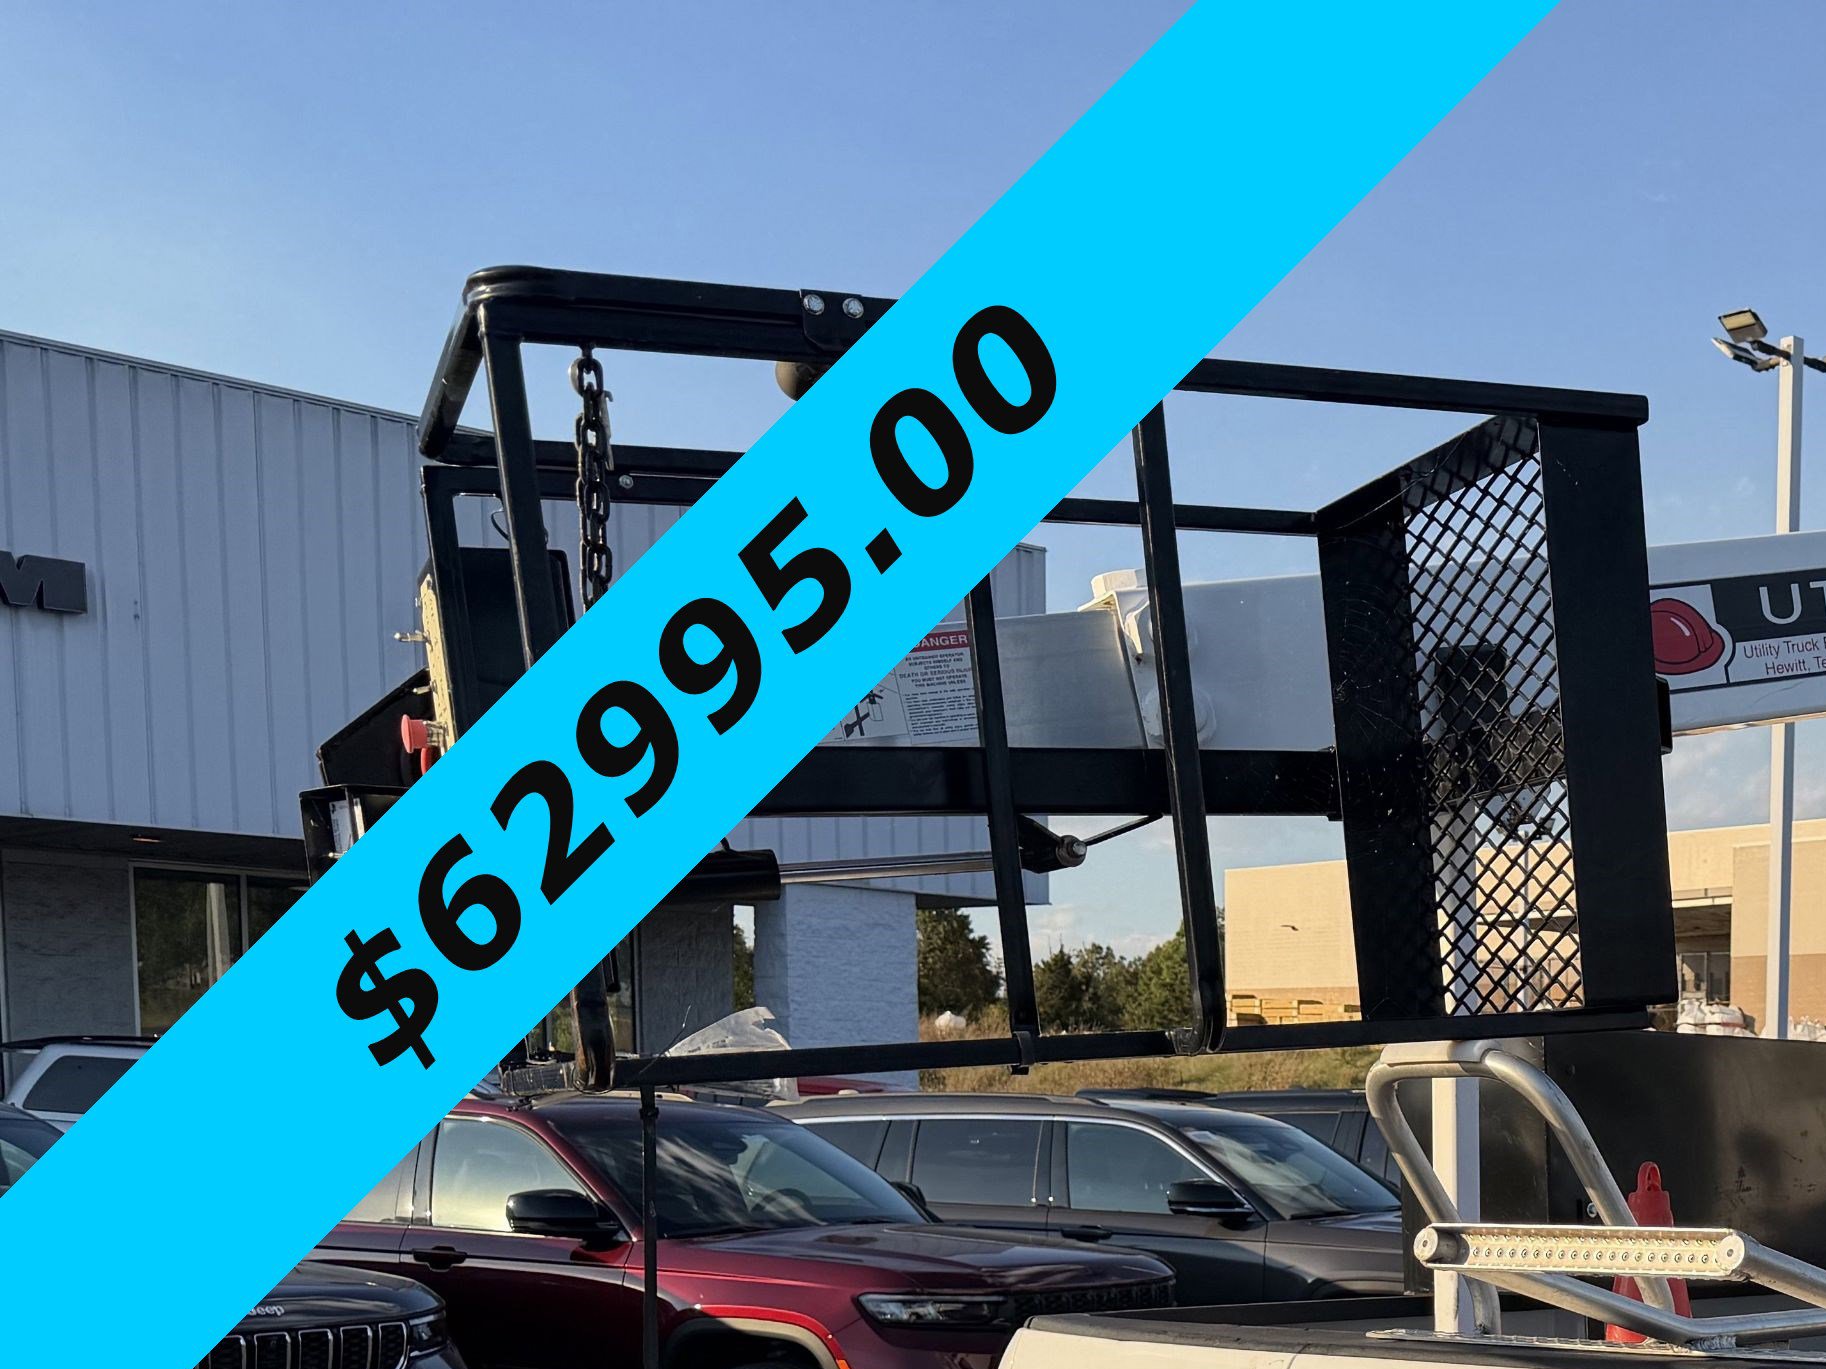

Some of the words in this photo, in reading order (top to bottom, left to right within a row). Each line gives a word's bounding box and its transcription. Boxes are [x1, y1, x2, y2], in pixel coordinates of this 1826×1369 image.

[1743, 642, 1780, 660] Utility
[1783, 637, 1820, 655] Truck
[1765, 658, 1811, 676] Hewitt,
